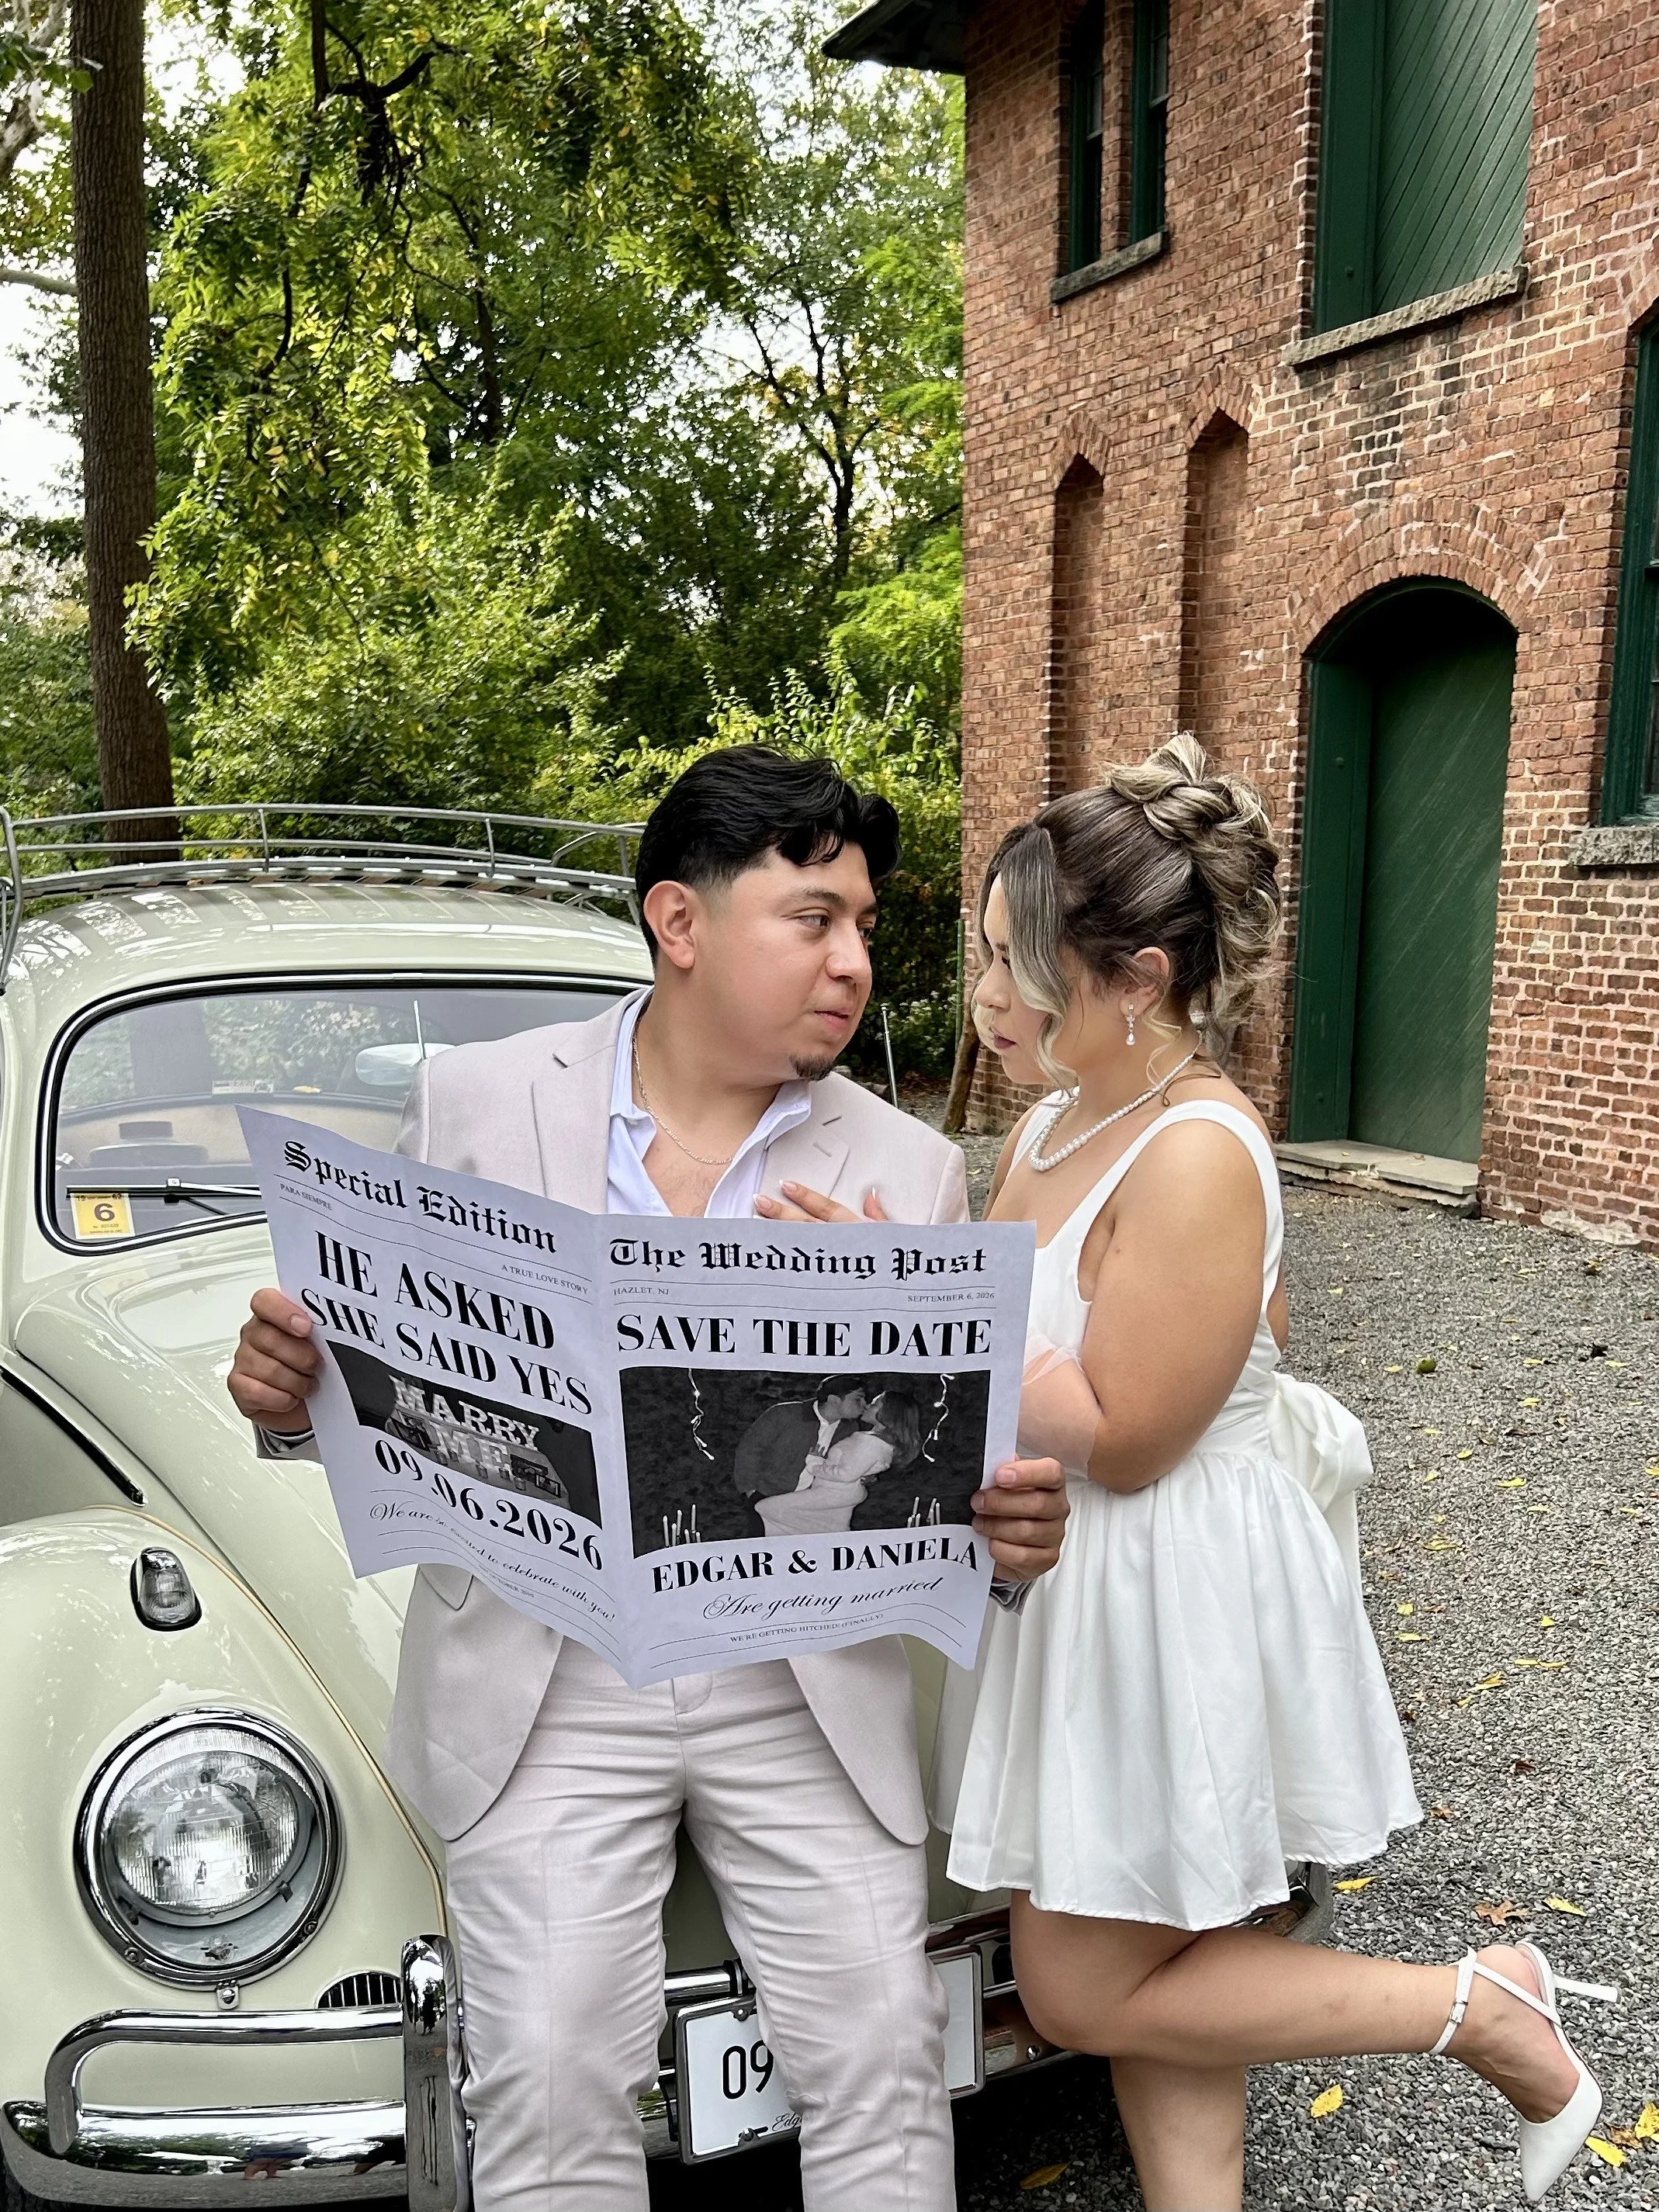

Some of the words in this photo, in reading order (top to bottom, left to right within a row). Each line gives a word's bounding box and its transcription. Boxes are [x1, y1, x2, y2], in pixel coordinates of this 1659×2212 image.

[94, 1203, 116, 1221] 6
[280, 1183, 300, 1196] PARA
[301, 1192, 332, 1210] SIEMPRE
[284, 1141, 409, 1208] Special
[417, 1186, 557, 1254] Edition
[501, 1264, 508, 1272] A
[509, 1265, 534, 1279] TRUE
[535, 1272, 559, 1286] LOVE
[560, 1279, 588, 1294] STORY
[610, 1238, 686, 1273] The
[698, 1242, 876, 1279] Wedding
[892, 1247, 987, 1281] Post
[315, 1231, 379, 1298] HE
[394, 1263, 554, 1349] ASKED
[908, 1293, 964, 1303] SEPTEMBER
[301, 1288, 386, 1349] SHE
[396, 1322, 497, 1383] SAID
[507, 1354, 592, 1415] YES
[617, 1314, 736, 1353] SAVE
[753, 1319, 851, 1357] THE
[869, 1320, 992, 1357] DATE
[389, 1375, 539, 1452] MARRY
[375, 1439, 602, 1570] 09.06.2026
[370, 1501, 414, 1521] We
[409, 1510, 433, 1521] are
[488, 1554, 499, 1564] to
[503, 1562, 559, 1588] celebrate
[562, 1586, 589, 1604] with
[590, 1601, 615, 1623] you!
[651, 1552, 774, 1594] EDGAR
[788, 1549, 818, 1574] &
[830, 1537, 978, 1573] DANIELA
[703, 1593, 762, 1621] Are
[760, 1594, 843, 1621] getting
[850, 1577, 944, 1604] married
[759, 1627, 797, 1638] GETTING
[772, 2113, 802, 2131] Edg
